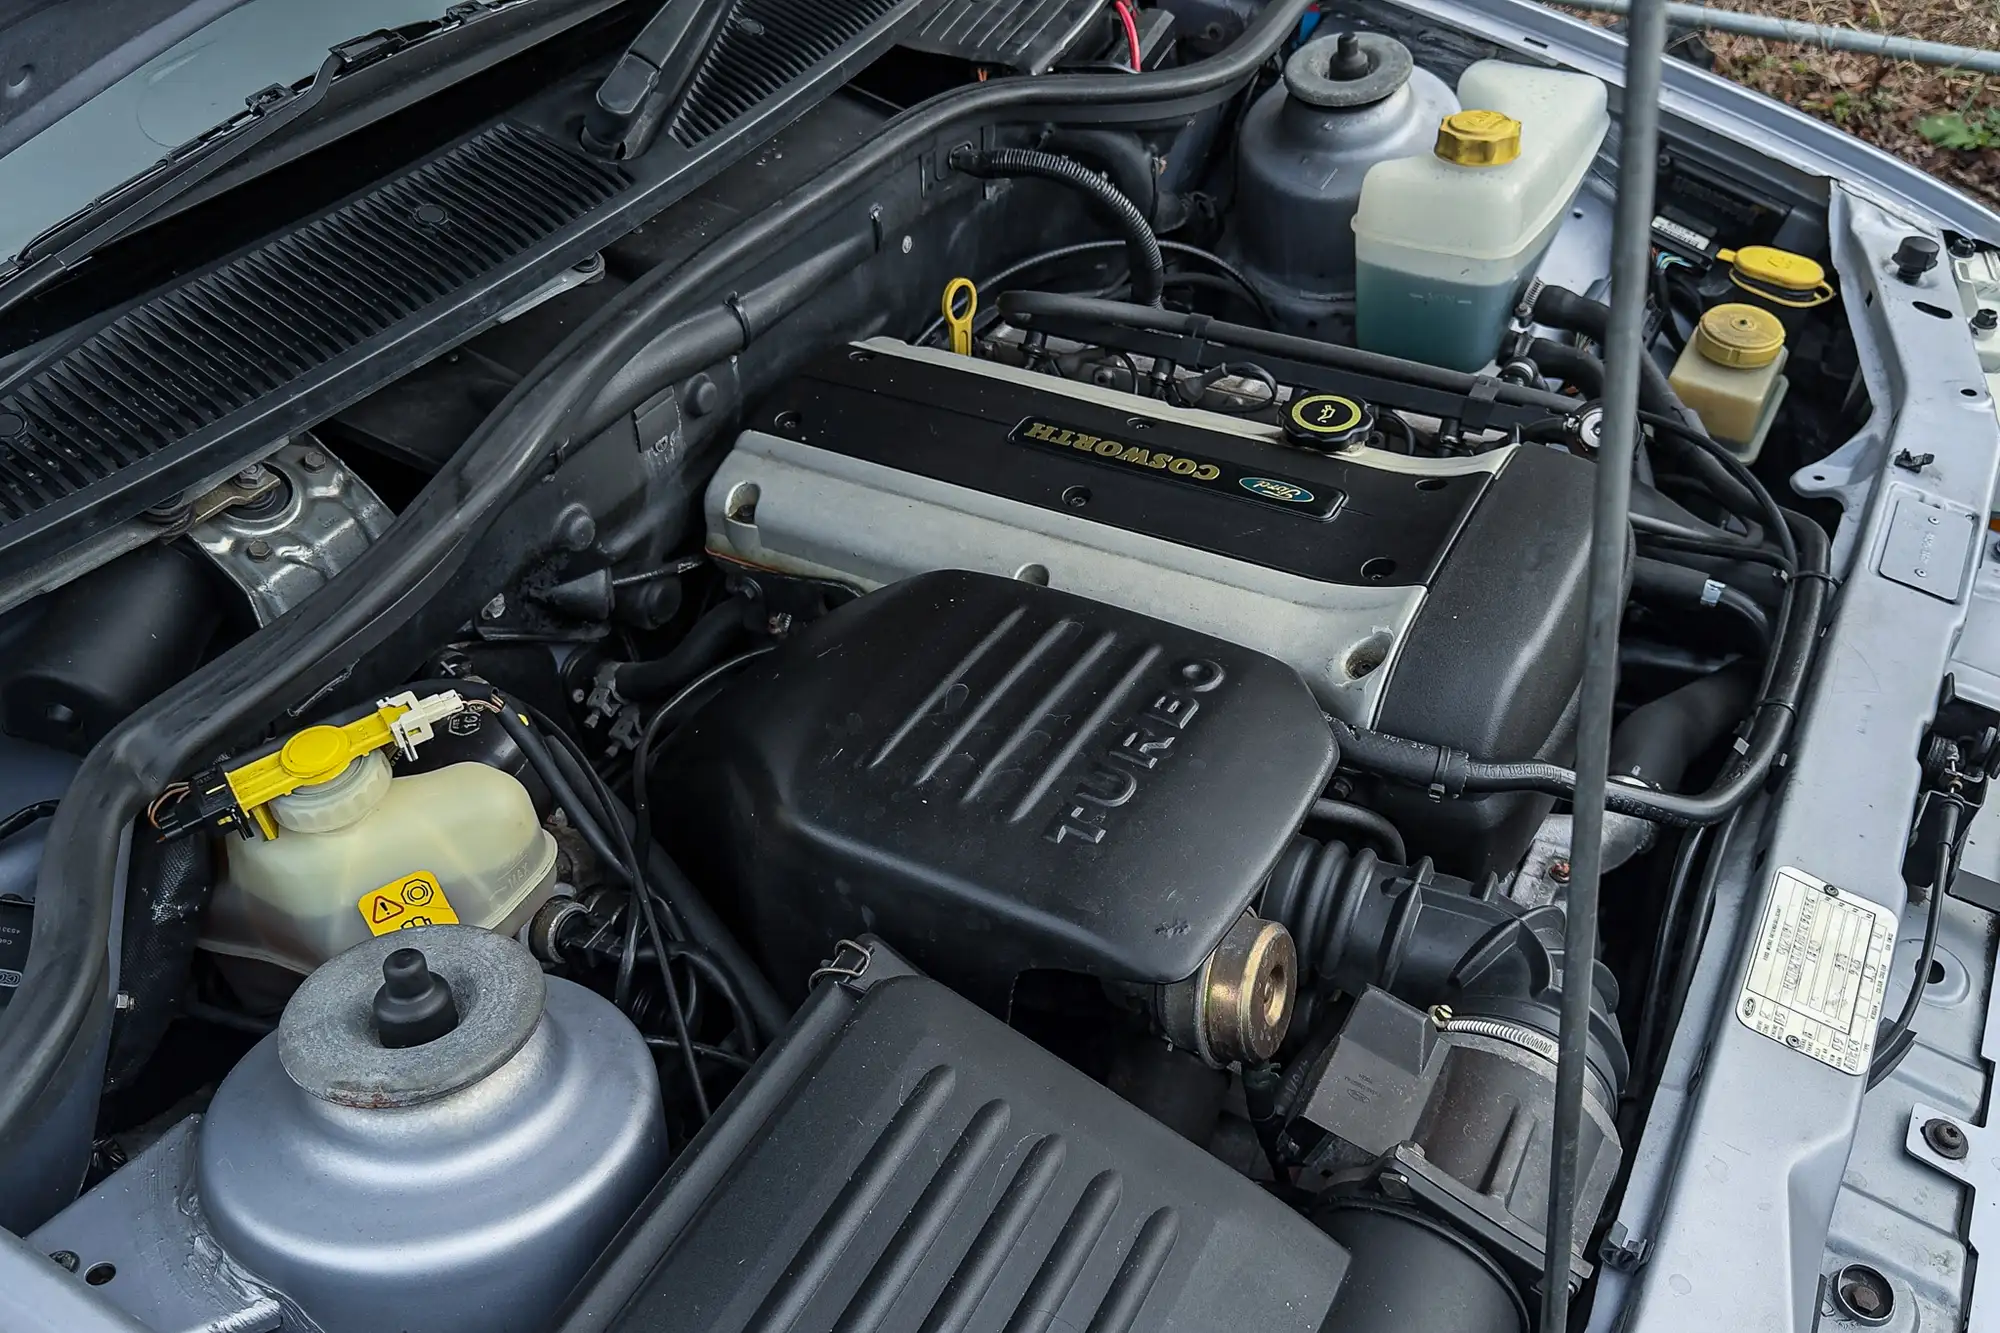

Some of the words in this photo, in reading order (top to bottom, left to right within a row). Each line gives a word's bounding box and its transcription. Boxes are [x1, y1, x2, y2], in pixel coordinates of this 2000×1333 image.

[1024, 421, 1221, 481] COSWORTH
[1246, 478, 1304, 501] Ford
[1045, 659, 1227, 844] TURBO
